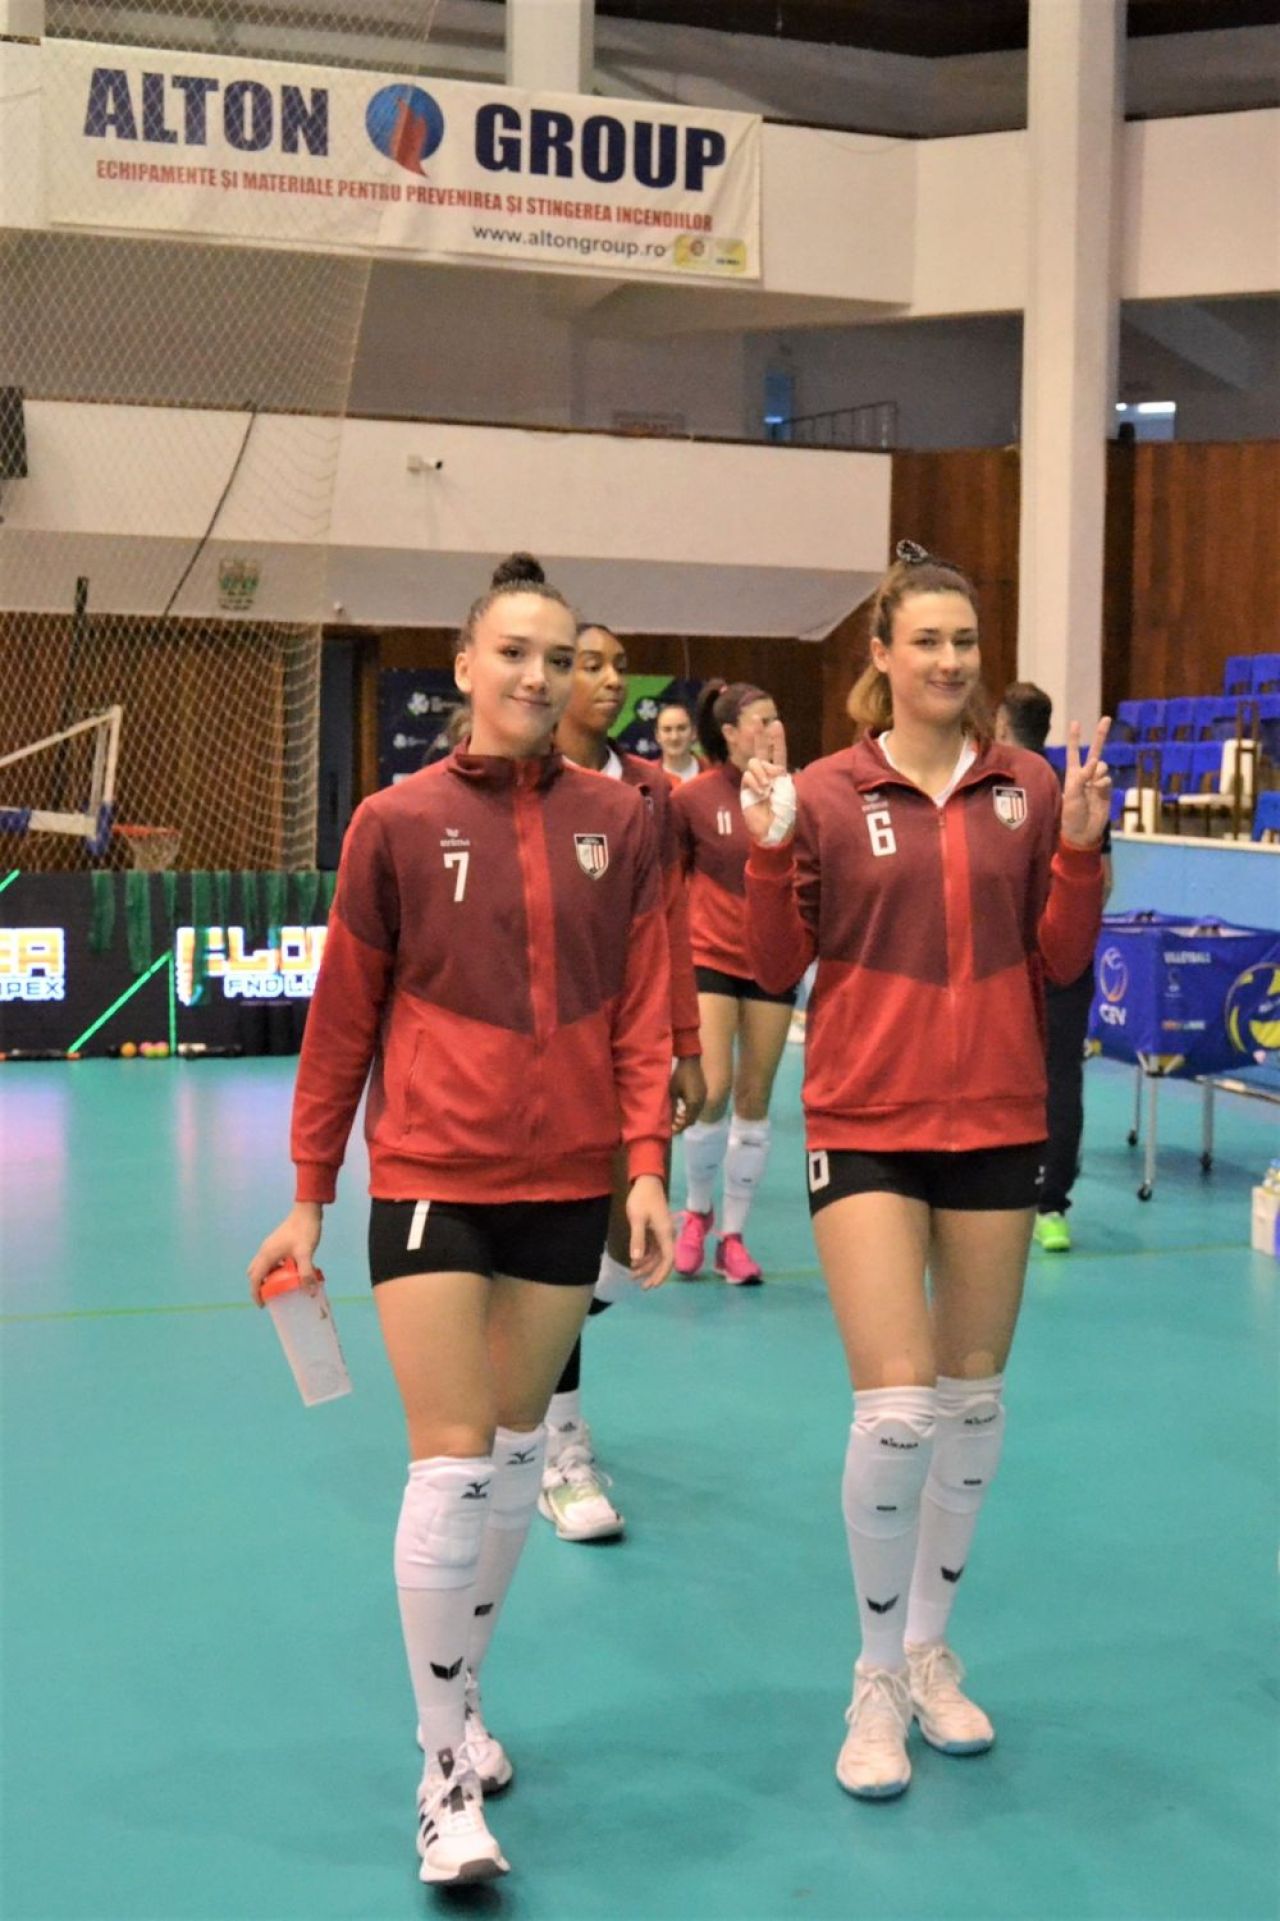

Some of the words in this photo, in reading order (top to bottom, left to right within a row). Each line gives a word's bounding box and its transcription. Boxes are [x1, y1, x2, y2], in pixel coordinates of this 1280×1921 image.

[83, 67, 329, 157] ALTON
[475, 103, 725, 191] GROUP
[96, 159, 217, 186] ECHIPAMENTE
[242, 172, 333, 197] MATERIALE
[338, 179, 402, 202] PENTRU
[406, 185, 503, 211] PREVENIREA
[527, 197, 612, 223] STINGEREA
[616, 207, 713, 233] INCENDIILOR
[473, 226, 666, 258] www.altongroup.ro
[717, 810, 732, 835] 11
[866, 810, 897, 857] 6
[443, 851, 470, 902] 7
